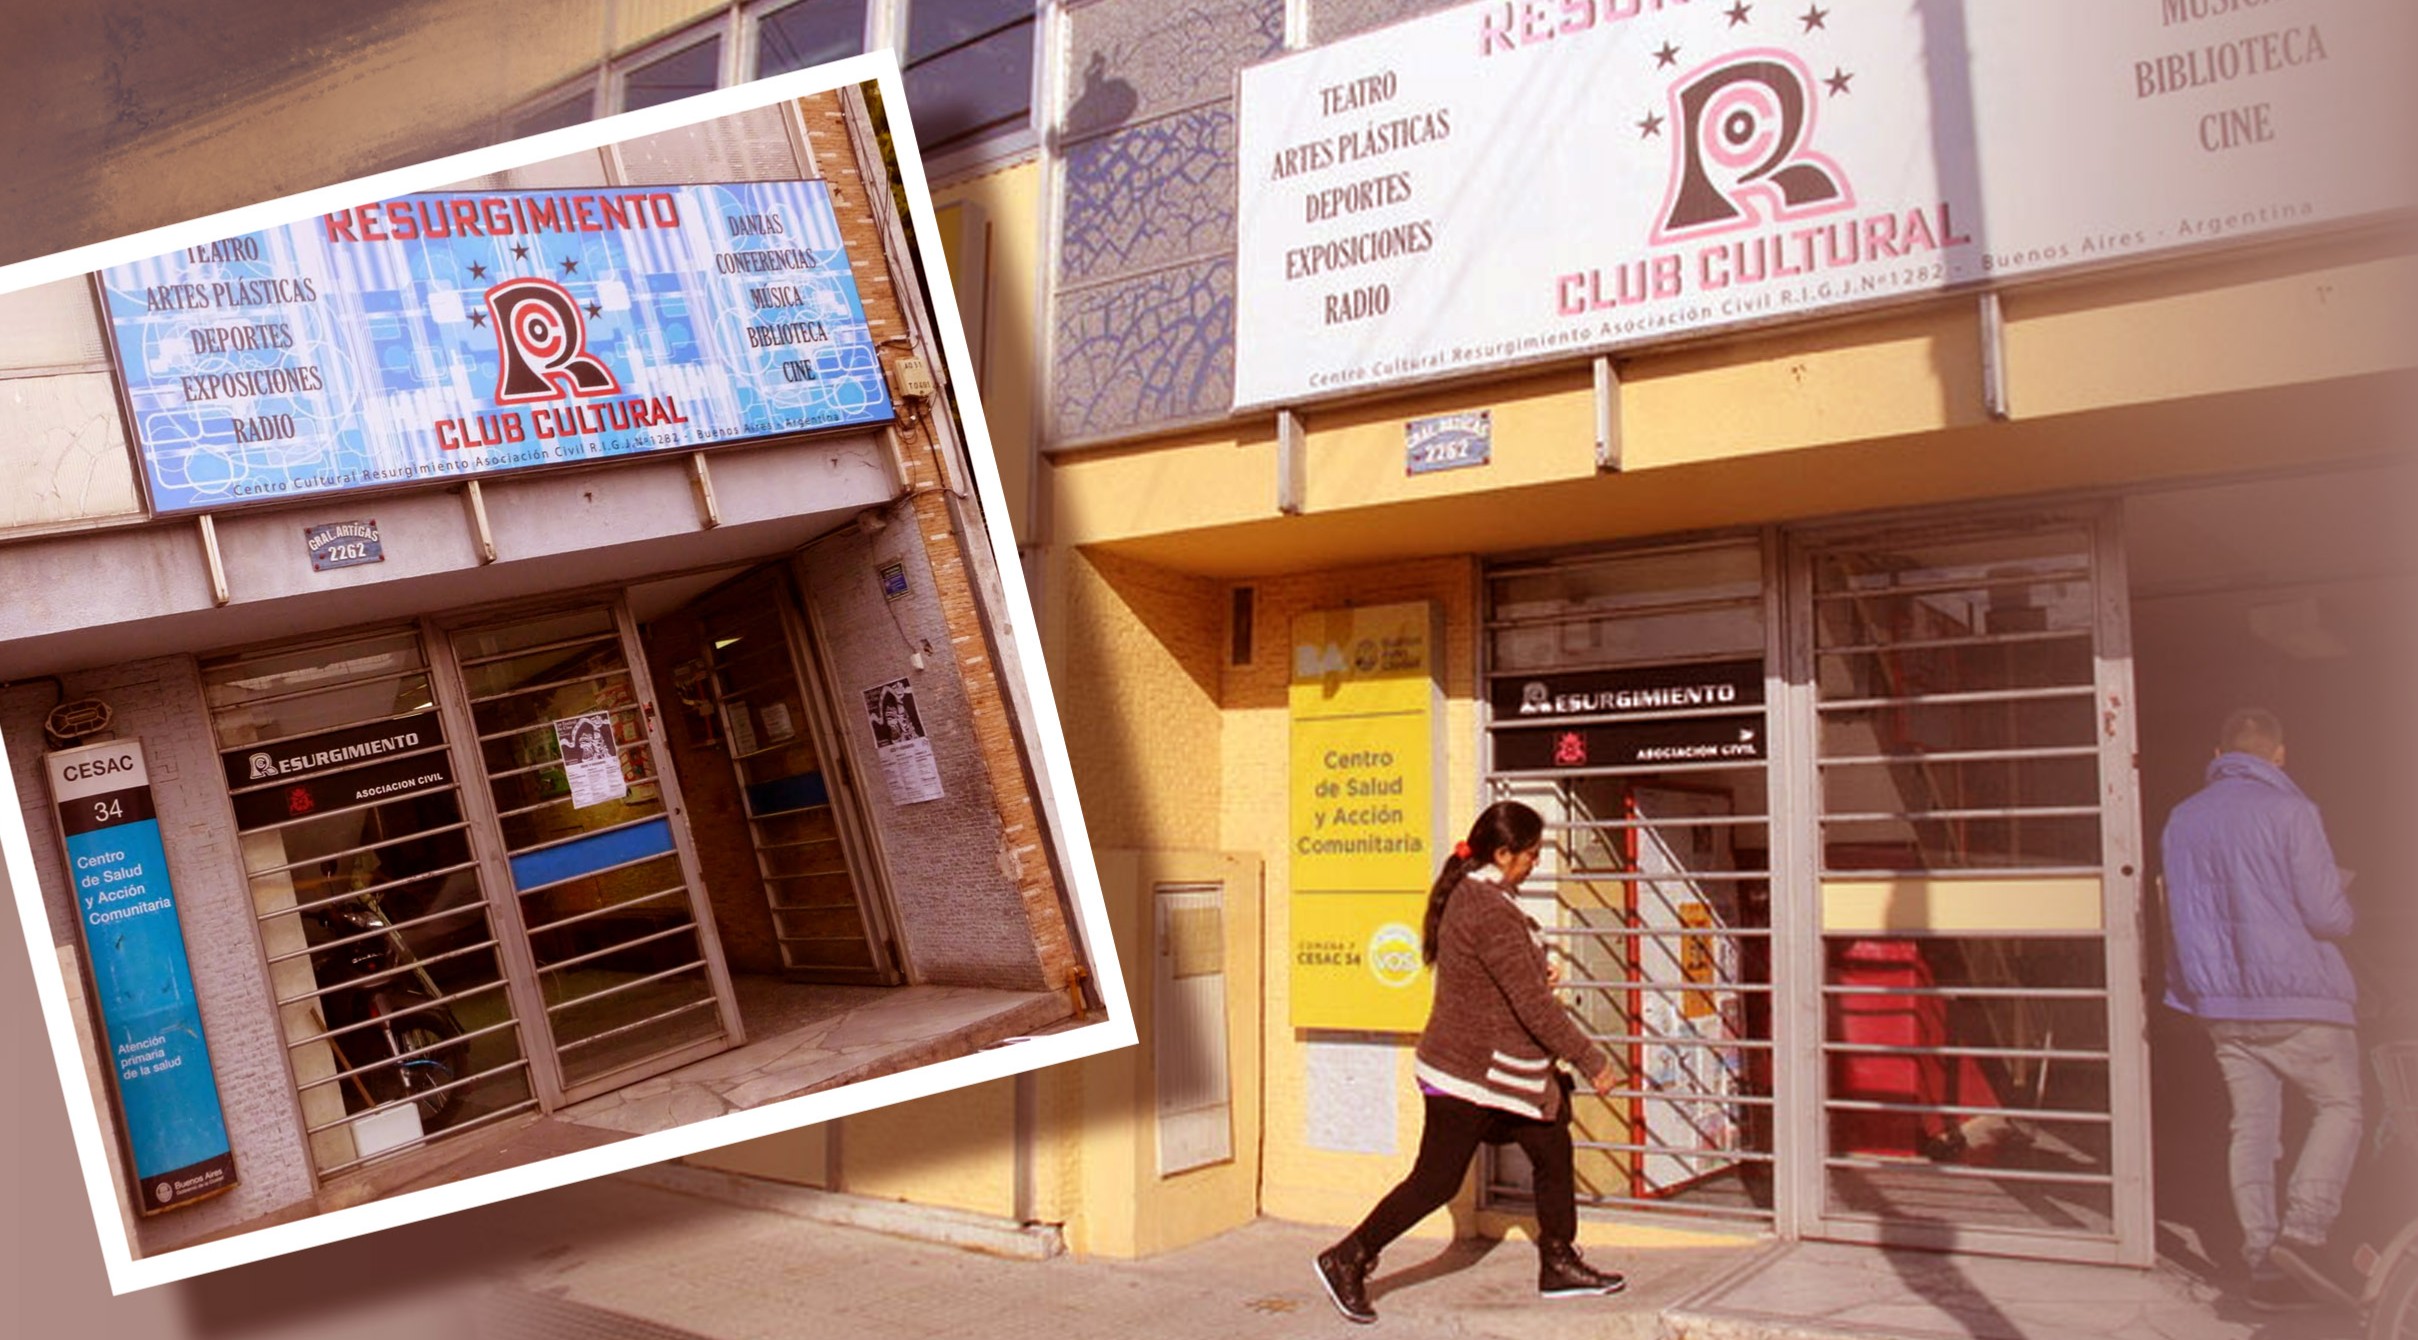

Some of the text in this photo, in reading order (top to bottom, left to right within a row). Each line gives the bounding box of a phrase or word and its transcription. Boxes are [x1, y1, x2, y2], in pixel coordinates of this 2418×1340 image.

[2134, 24, 2328, 98] BIBLIOTECA
[1319, 70, 1398, 117] TEATRO
[2198, 102, 2275, 152] CINE
[1271, 108, 1451, 181] ARTES PLÁSTICAS
[1305, 171, 1412, 224] DEPORTES
[323, 193, 680, 242] RESURGIMIENTO
[728, 214, 783, 236] DANZAS
[716, 248, 817, 275] CONFERENCIAS
[1285, 219, 1434, 281] EXPOSICIONES
[1556, 201, 1972, 317] CLUB CULTURAL
[146, 278, 316, 311] ARTES PLÁSTICAS
[750, 283, 804, 309] MÚSICA
[1309, 365, 1367, 388] Centro
[1371, 350, 1444, 376] Cultural
[1451, 328, 1592, 361] Resurgimiento
[1599, 307, 1712, 336] Asociación
[1721, 293, 1771, 316] Civil
[1981, 243, 2069, 270] Buenos
[2081, 230, 2146, 253] Aires
[2178, 201, 2315, 236] Argentina
[1324, 283, 1390, 326] RADIO
[191, 324, 293, 354] DEPORTES
[747, 321, 828, 348] BIBLIOTECA
[182, 366, 323, 401] EXPOSICIONES
[783, 360, 816, 383] CINE
[232, 413, 295, 444] RADIO
[434, 396, 689, 451] CLUB CULTURAL
[233, 482, 287, 496] Centro
[294, 471, 356, 488] Cultural
[363, 459, 469, 481] Resurgimiento
[475, 449, 550, 467] Asociación
[554, 445, 585, 457] Civil
[697, 423, 738, 439] Buenos
[744, 422, 772, 433] Aires
[786, 413, 840, 427] Argentina
[328, 542, 367, 562] 2262
[1518, 681, 1735, 714] RESURGIMIENTO
[63, 755, 134, 782] CESAC
[249, 732, 419, 780] RESURGIMIENTO
[1324, 750, 1394, 769] Centro
[356, 772, 444, 799] ASOCIACION CIVIL
[1315, 776, 1403, 798] de Salud
[94, 799, 123, 822] 34
[1314, 804, 1404, 828] y Acción
[1296, 835, 1423, 854] Comunitaria
[77, 850, 125, 869] Centro
[81, 864, 142, 888] de Salud
[85, 884, 146, 910] y Acción
[89, 896, 172, 925] Comunitaria
[117, 1035, 166, 1055] Atención
[120, 1048, 166, 1069] primaria
[123, 1056, 182, 1080] de la salud
